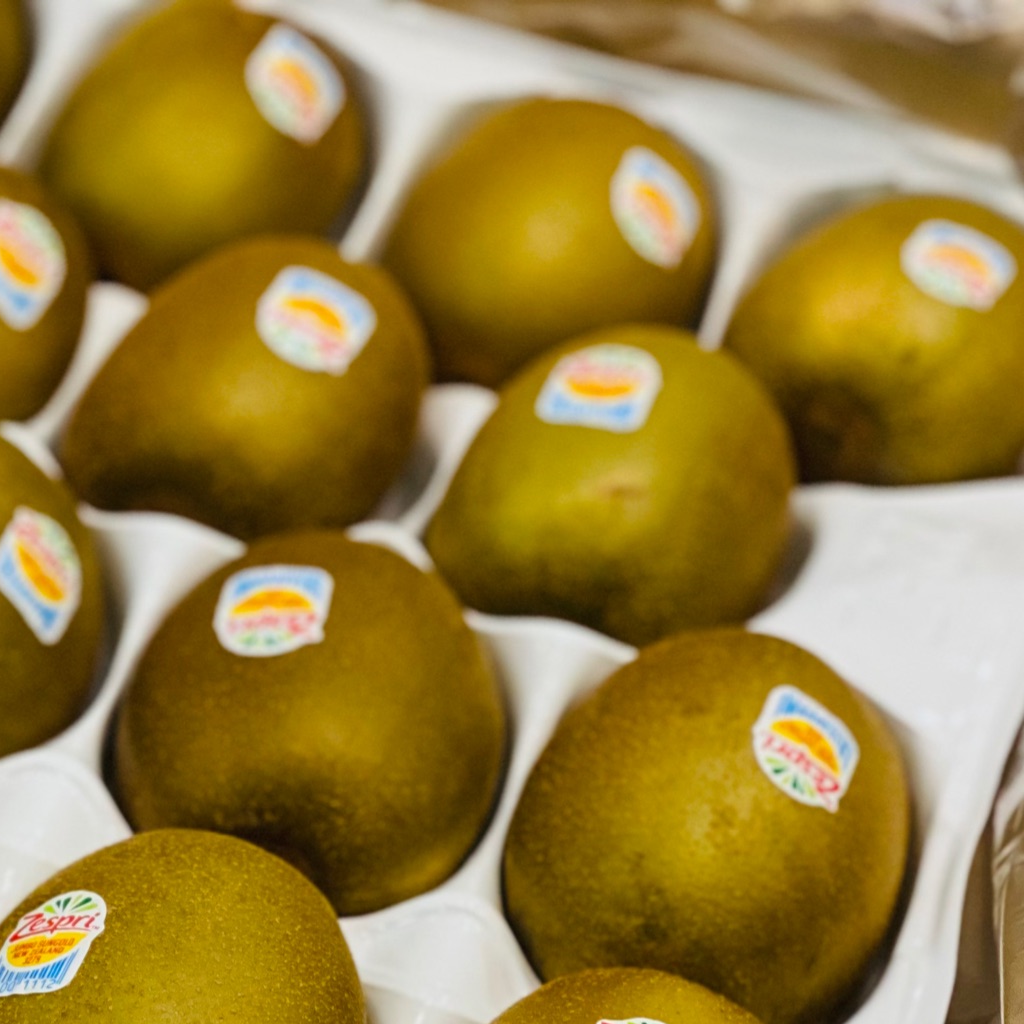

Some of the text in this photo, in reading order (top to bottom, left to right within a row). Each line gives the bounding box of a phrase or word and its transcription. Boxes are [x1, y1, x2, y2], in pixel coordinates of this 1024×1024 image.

[9, 912, 101, 943] Zespri
[38, 938, 75, 948] SUNGOLD
[13, 947, 65, 959] NEW ZEALAND
